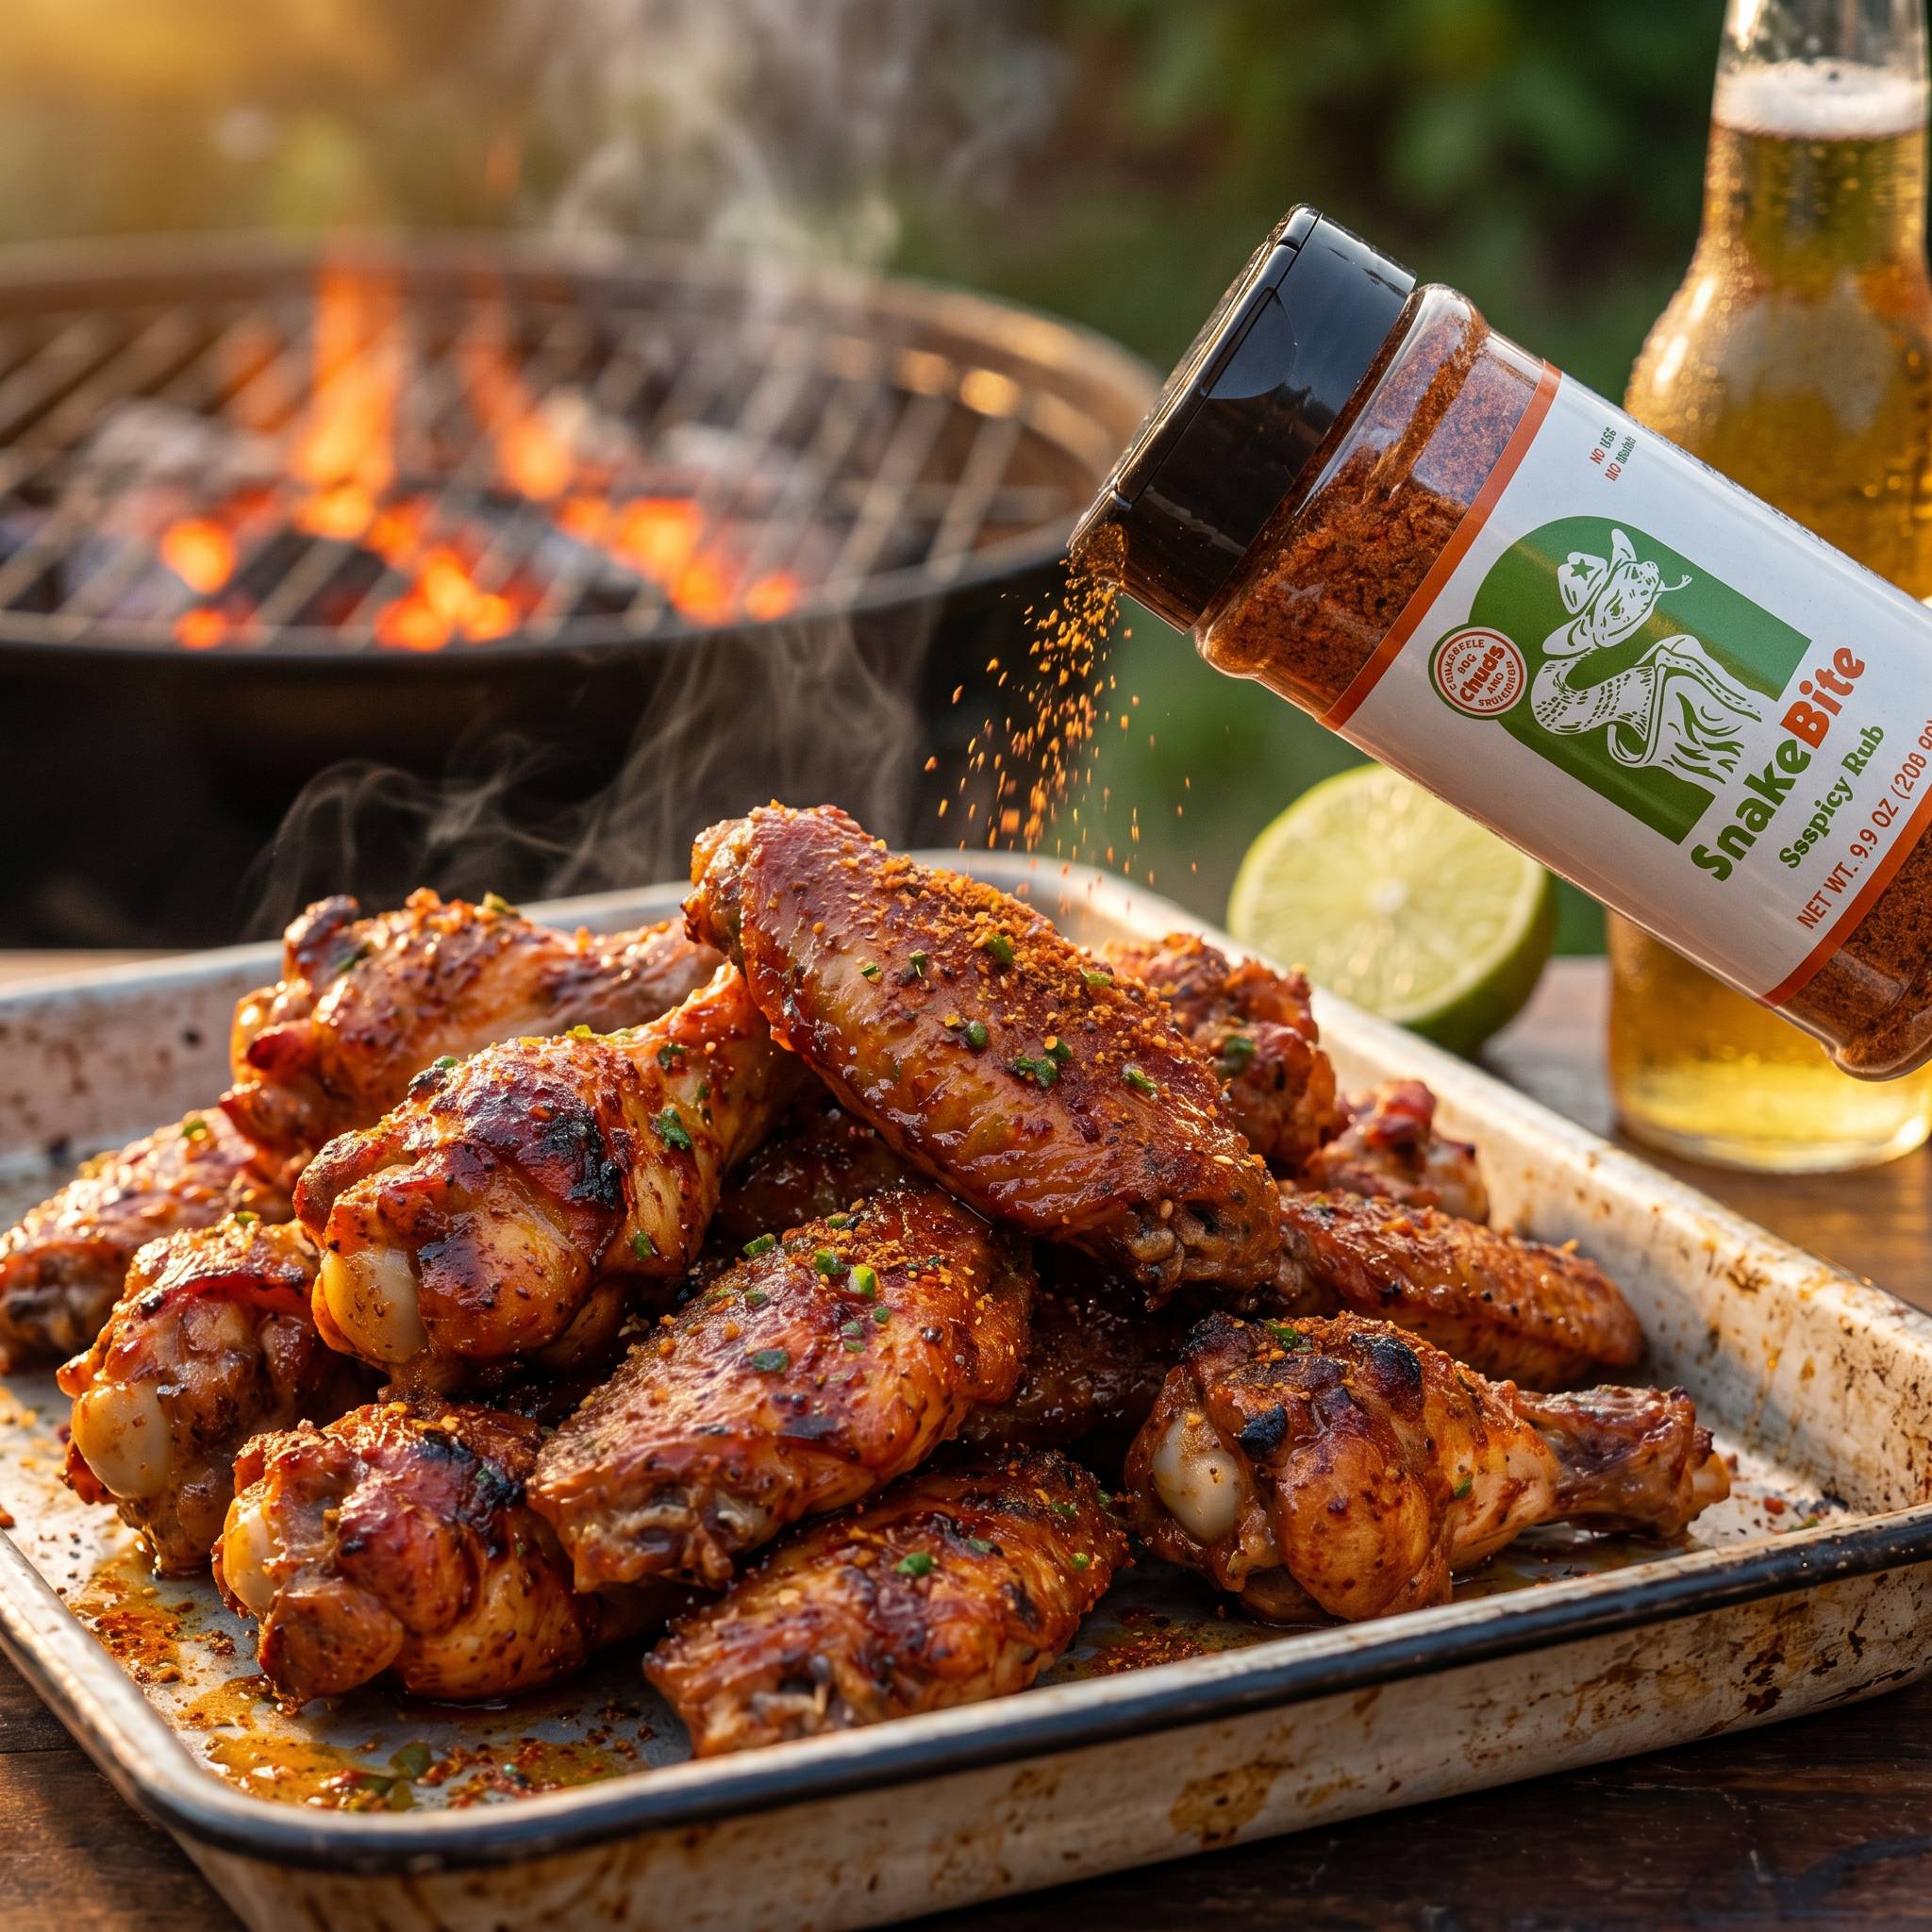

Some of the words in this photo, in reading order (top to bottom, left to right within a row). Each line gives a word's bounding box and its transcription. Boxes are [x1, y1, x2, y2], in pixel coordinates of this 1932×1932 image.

[1590, 448, 1606, 465] NO
[1459, 645, 1506, 702] Chuds
[1779, 776, 1854, 869] Ssspicy
[1841, 725, 1884, 776] Rub
[1796, 891, 1832, 929] NET
[1850, 828, 1878, 858] 9.9
[1872, 798, 1900, 828] OZ
